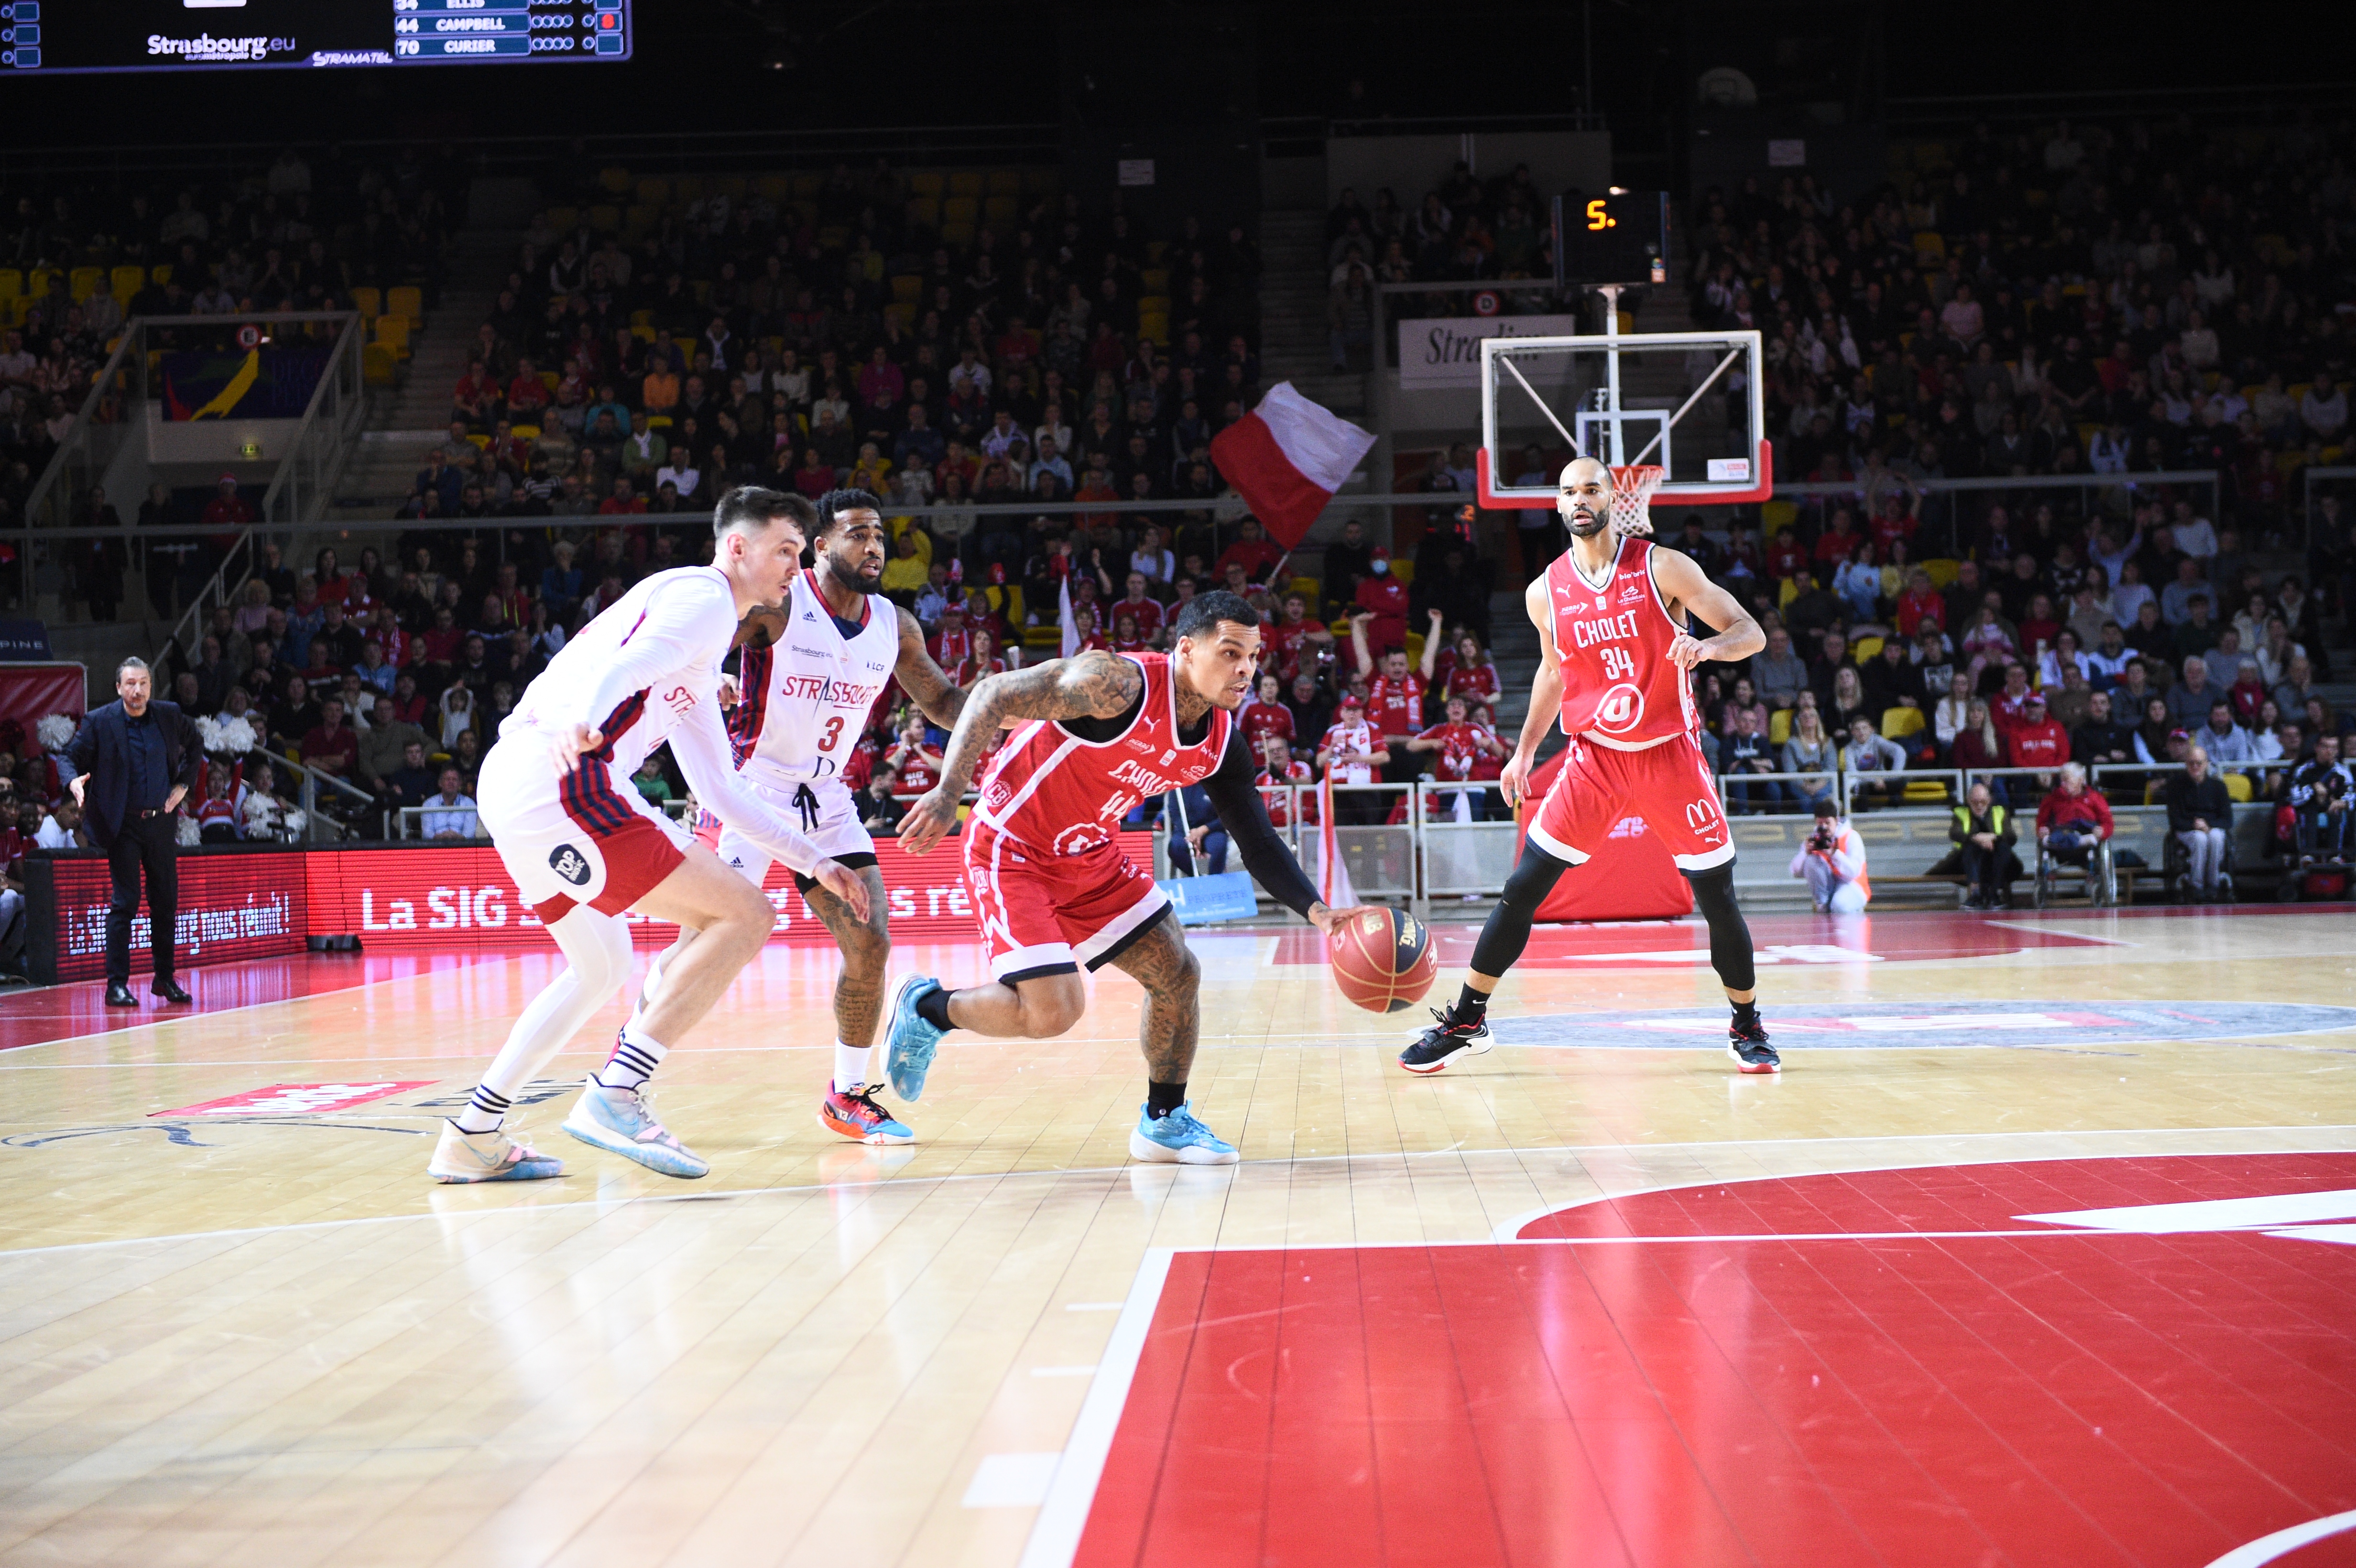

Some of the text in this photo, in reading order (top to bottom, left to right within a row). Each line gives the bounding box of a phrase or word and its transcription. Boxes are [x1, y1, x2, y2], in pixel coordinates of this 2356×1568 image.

[397, 18, 418, 33] 44
[436, 17, 506, 32] CAMPBELL
[147, 33, 295, 60] Strasbourg.eu
[397, 39, 496, 55] 70 CURIER
[1573, 610, 1638, 648] CHOLET
[1600, 646, 1635, 680] 34
[818, 716, 844, 752] 3
[1694, 819, 1720, 835] CHOLET
[555, 850, 575, 876] TOP
[362, 888, 417, 930] La
[428, 885, 508, 928] SIG
[201, 906, 238, 942] nous
[838, 1109, 848, 1121] 13
